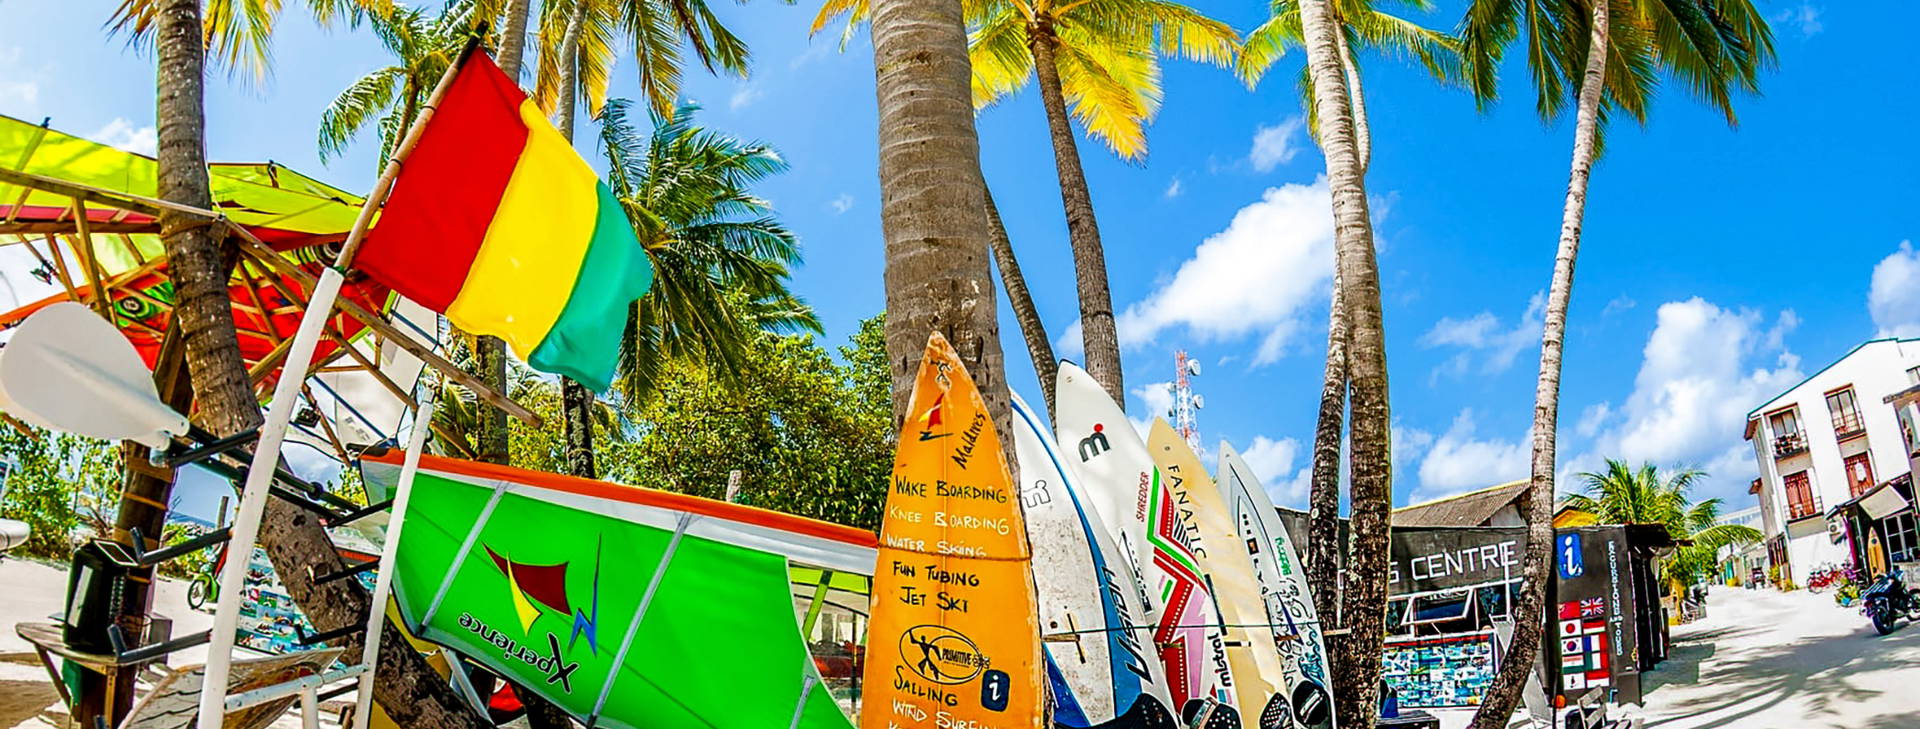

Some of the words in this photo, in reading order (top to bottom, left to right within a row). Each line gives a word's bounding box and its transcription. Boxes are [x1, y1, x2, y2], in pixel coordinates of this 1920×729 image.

[895, 474, 927, 498] WAKE
[936, 480, 1008, 504] BOARDING
[1136, 471, 1149, 523] SHREDDER
[889, 503, 922, 523] KNEE
[934, 511, 1009, 536] BOARDING
[1168, 464, 1207, 559] FANATIC
[886, 533, 925, 552] WATER
[892, 561, 916, 577] FUN
[925, 565, 980, 588] TUBING
[1411, 540, 1519, 581] CENTRE
[899, 586, 927, 607] JET
[936, 592, 969, 613] SKI
[458, 612, 580, 694] Xperience
[1207, 632, 1232, 688] mistral
[893, 698, 928, 722] WIND
